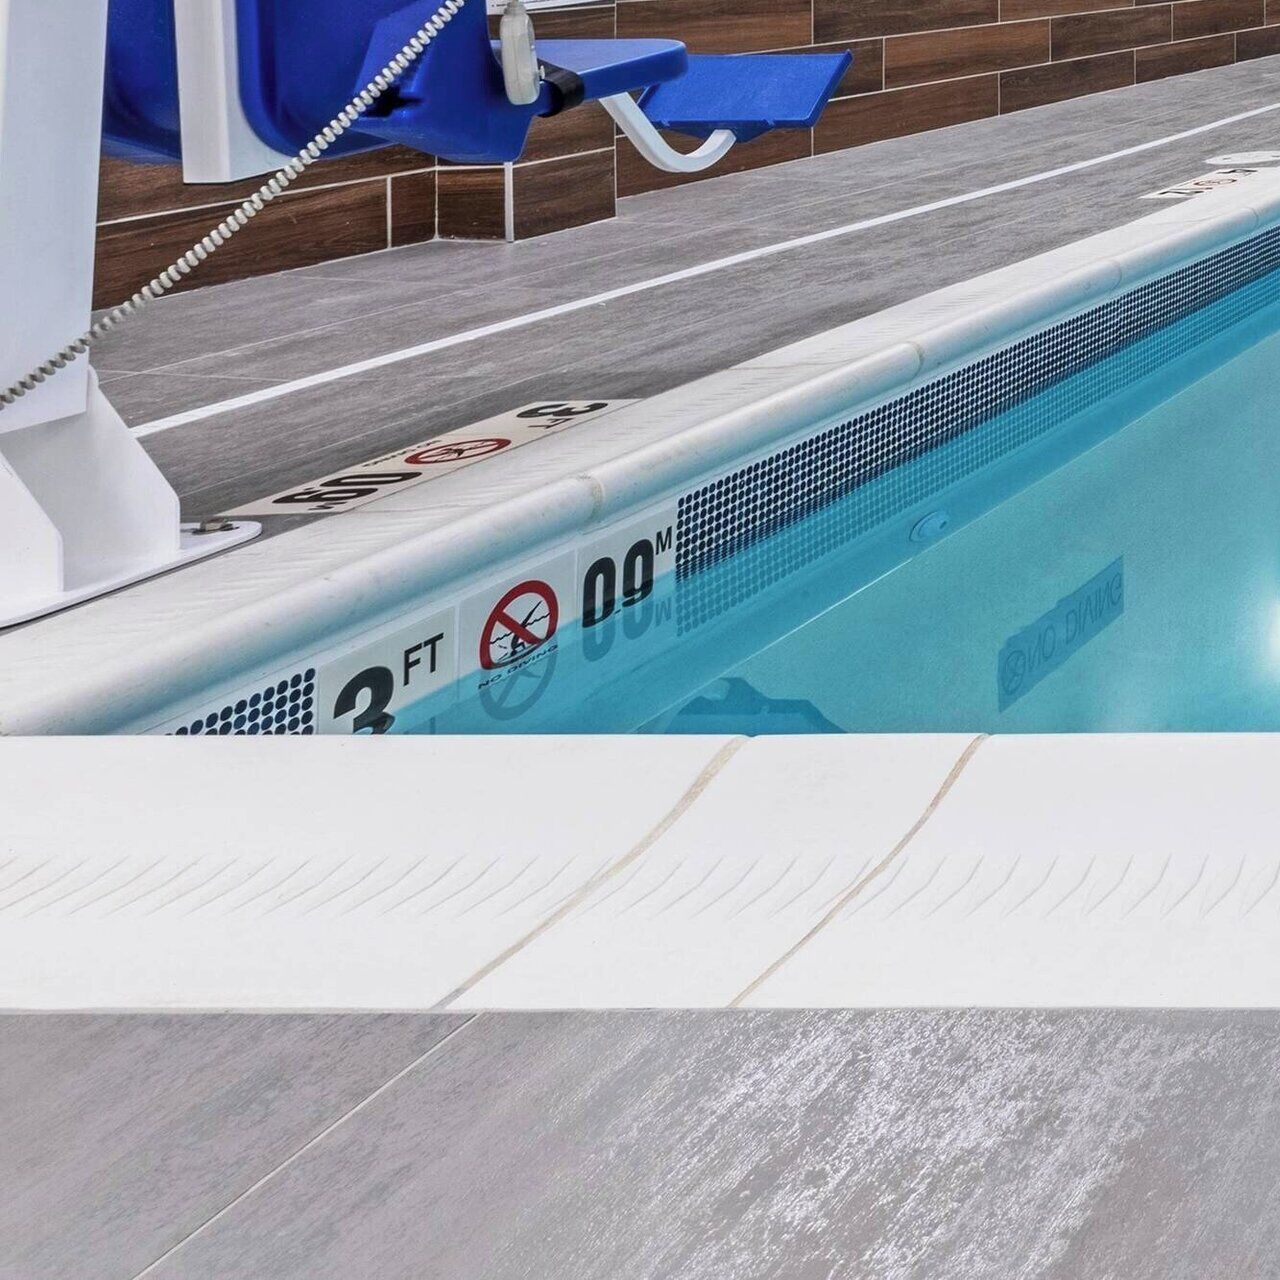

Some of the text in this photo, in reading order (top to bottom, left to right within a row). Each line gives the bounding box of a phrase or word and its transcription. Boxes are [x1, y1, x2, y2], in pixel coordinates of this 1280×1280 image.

[516, 402, 609, 419] 3
[656, 526, 673, 555] M
[333, 631, 444, 735] 3 FT
[478, 644, 559, 689] NO DIVING
